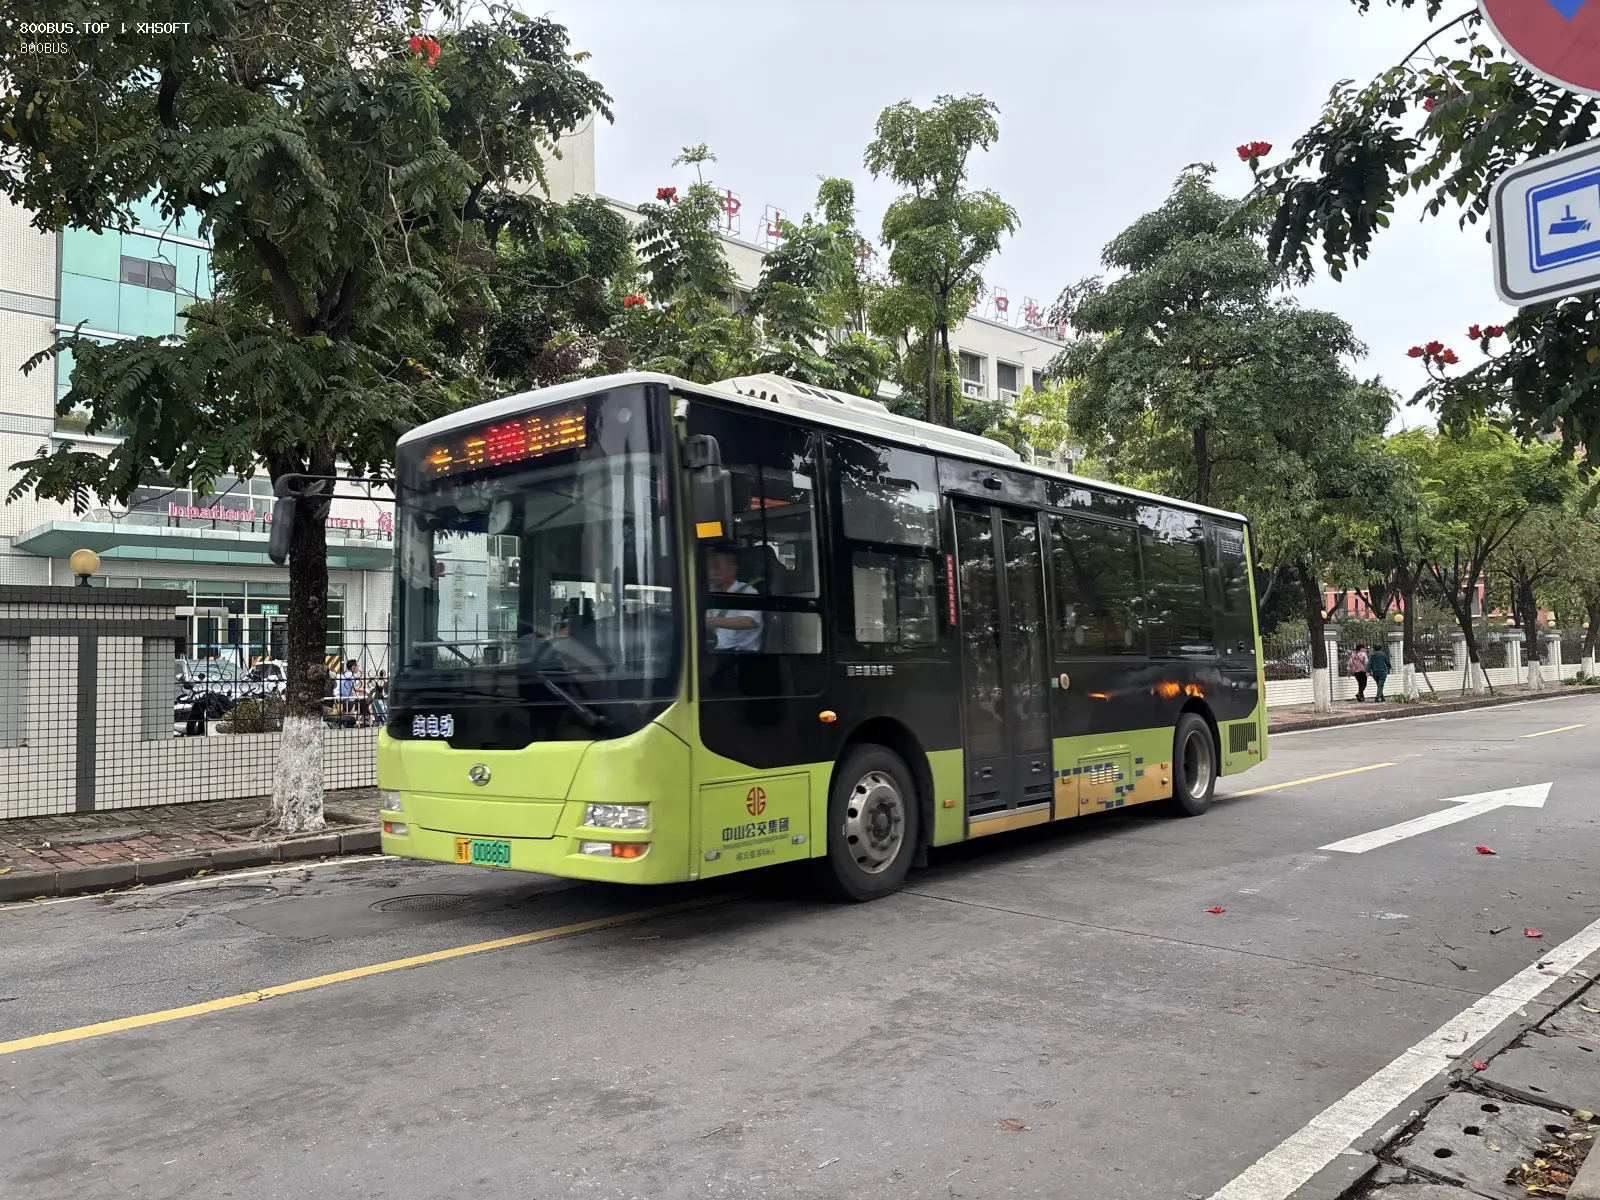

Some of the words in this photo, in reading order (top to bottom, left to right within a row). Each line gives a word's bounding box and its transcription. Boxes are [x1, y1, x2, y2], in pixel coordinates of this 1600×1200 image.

[168, 501, 256, 523] Inpatient
[721, 817, 790, 843] 中山公交集团
